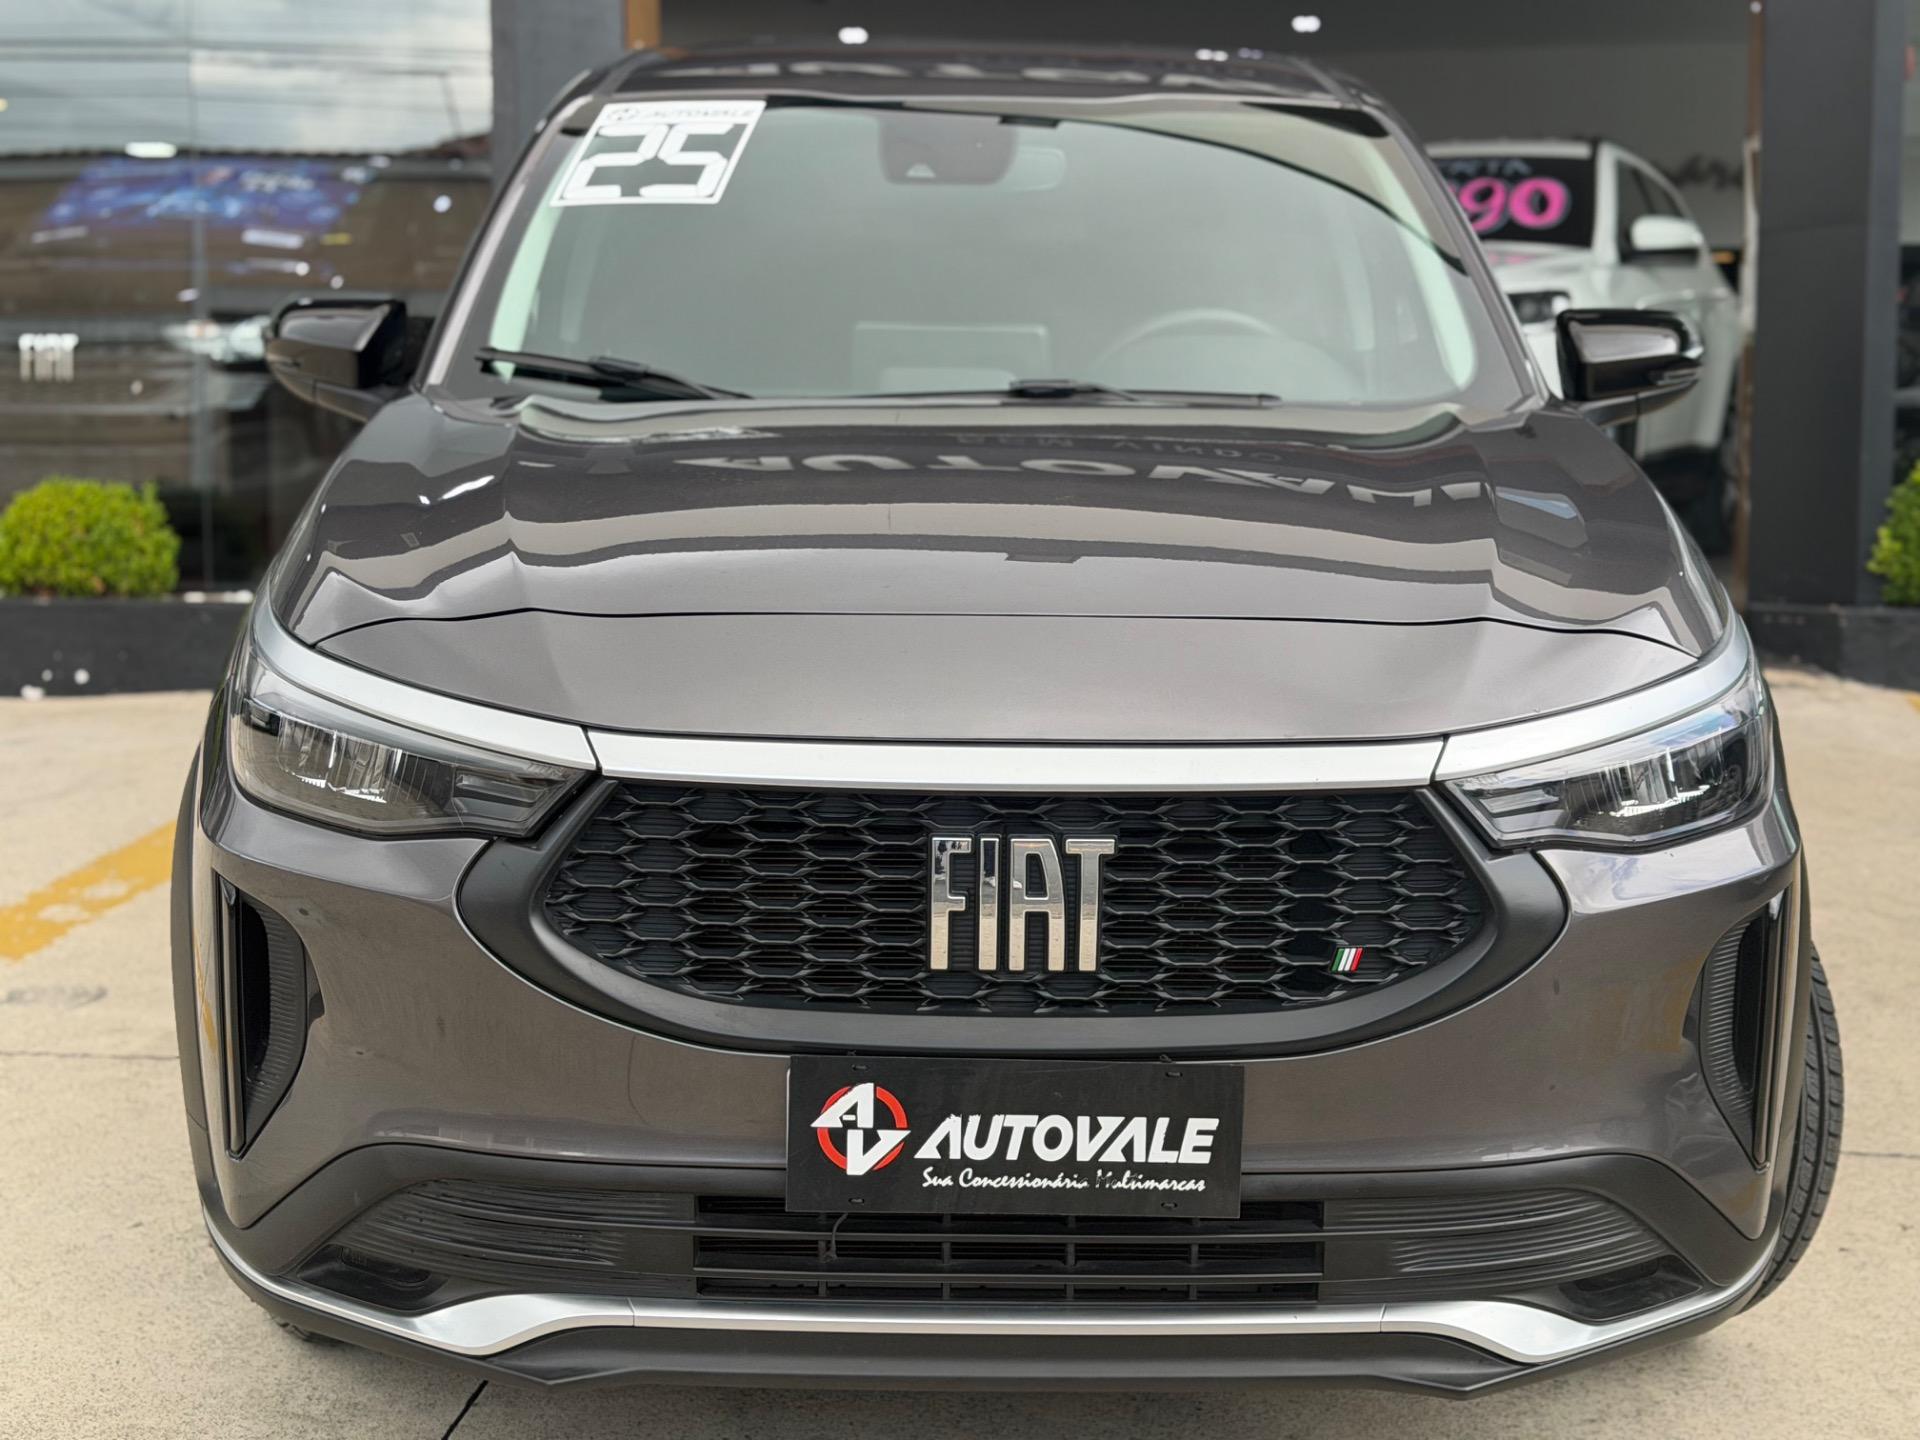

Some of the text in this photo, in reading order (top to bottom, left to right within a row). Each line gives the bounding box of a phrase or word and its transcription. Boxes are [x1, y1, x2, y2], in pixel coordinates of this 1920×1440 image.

[562, 123, 734, 200] 25
[930, 837, 1116, 971] FIAT
[913, 1114, 1220, 1164] AUTOVALE
[922, 1166, 954, 1188] Sua
[958, 1167, 1089, 1190] Concessionária
